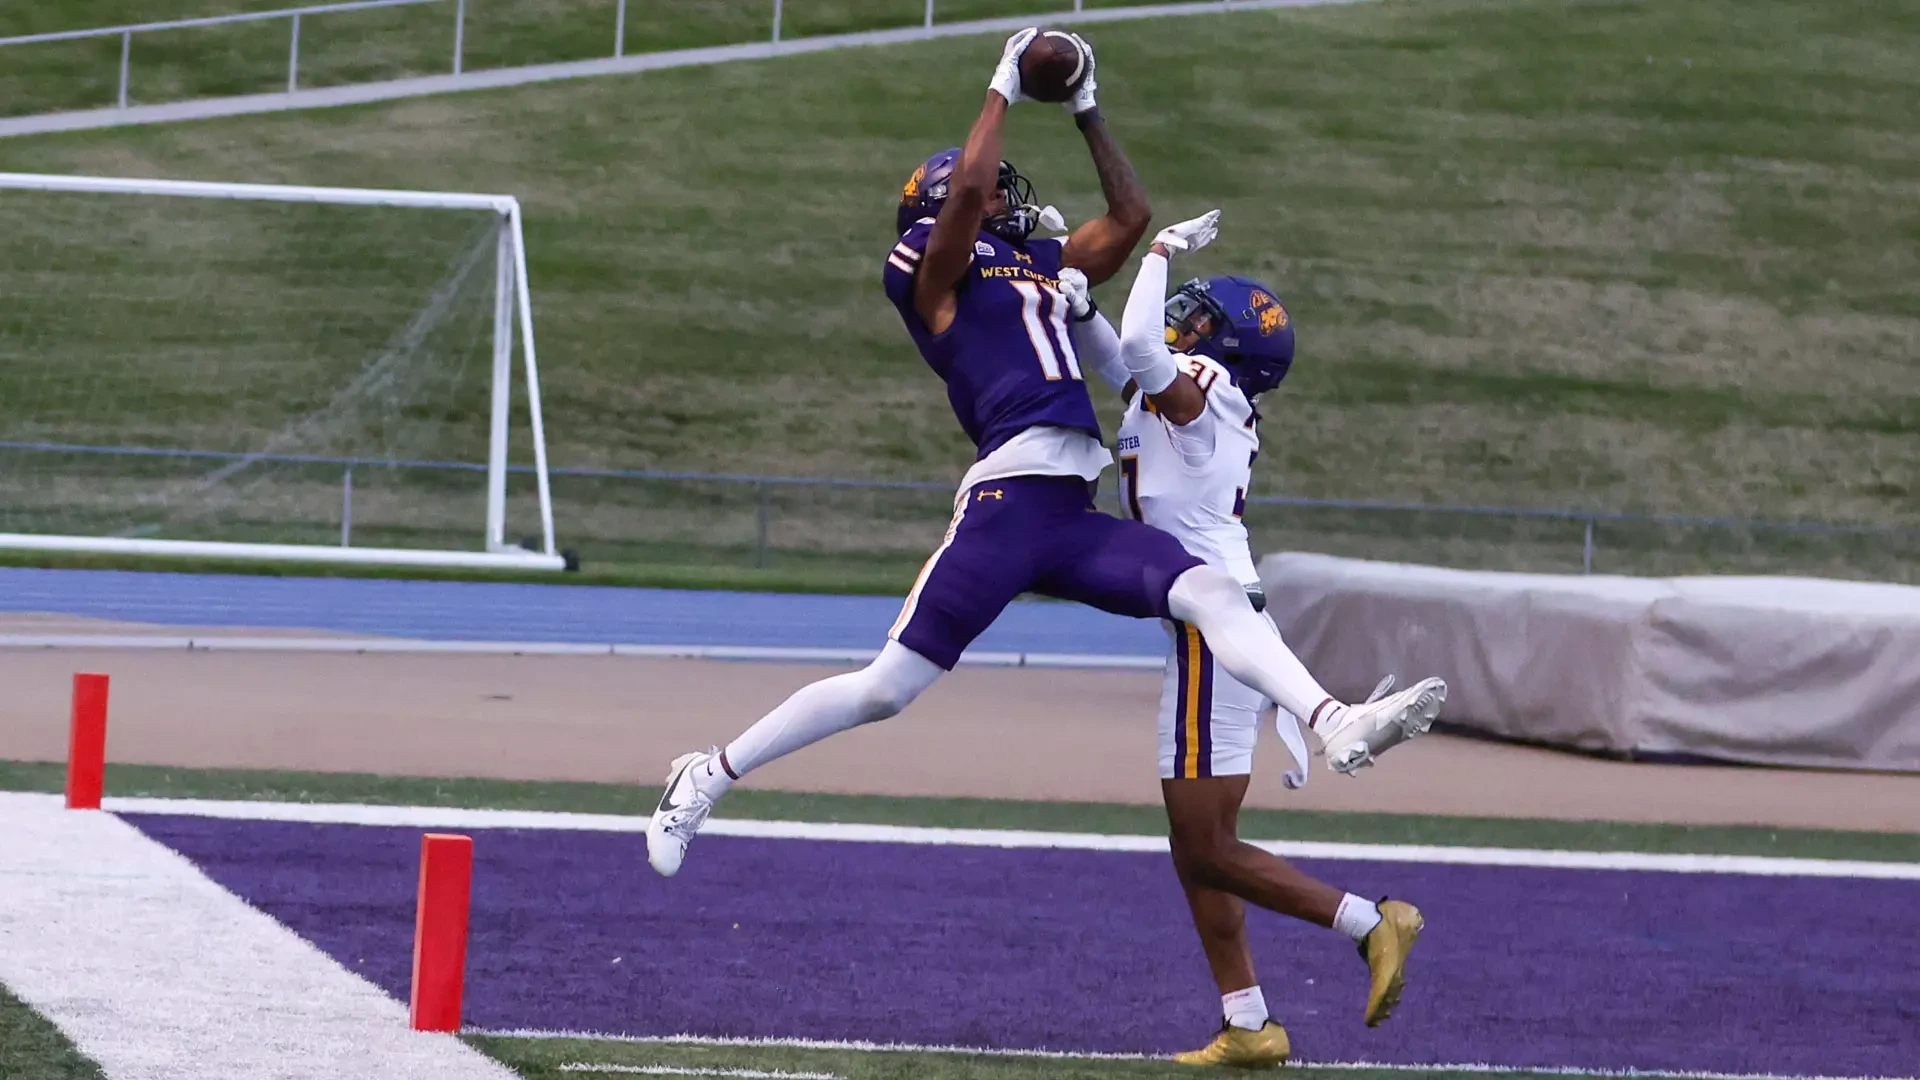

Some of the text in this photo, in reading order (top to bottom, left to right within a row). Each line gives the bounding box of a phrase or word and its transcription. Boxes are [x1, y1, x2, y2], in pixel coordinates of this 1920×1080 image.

[980, 266, 1060, 289] WEST CHEST
[1008, 280, 1084, 381] 11
[1189, 360, 1219, 395] 31
[1118, 435, 1141, 450] STER
[1119, 453, 1144, 523] 1
